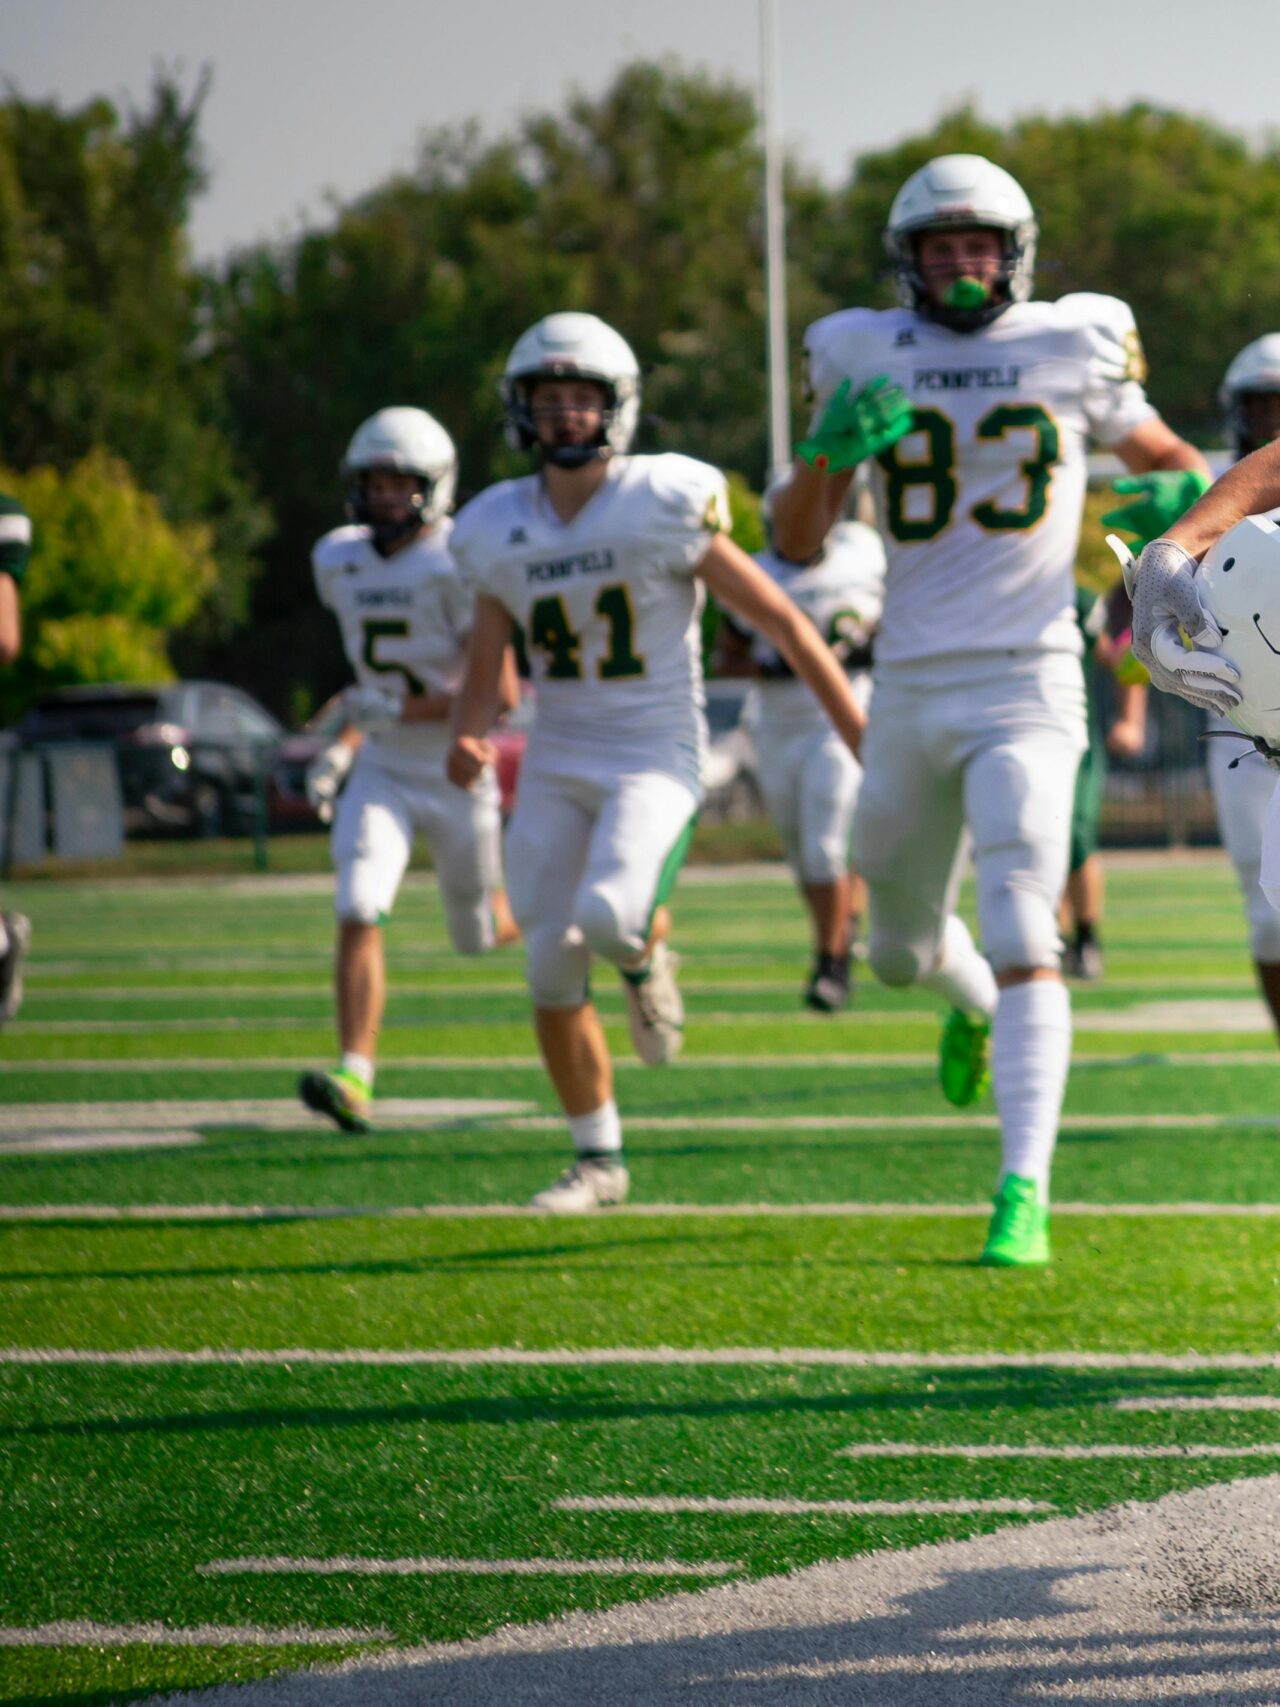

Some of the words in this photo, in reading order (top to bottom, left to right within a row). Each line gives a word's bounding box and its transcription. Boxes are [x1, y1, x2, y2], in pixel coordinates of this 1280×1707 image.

[875, 402, 1062, 543] 83
[361, 616, 427, 698] 5
[530, 580, 646, 681] 41
